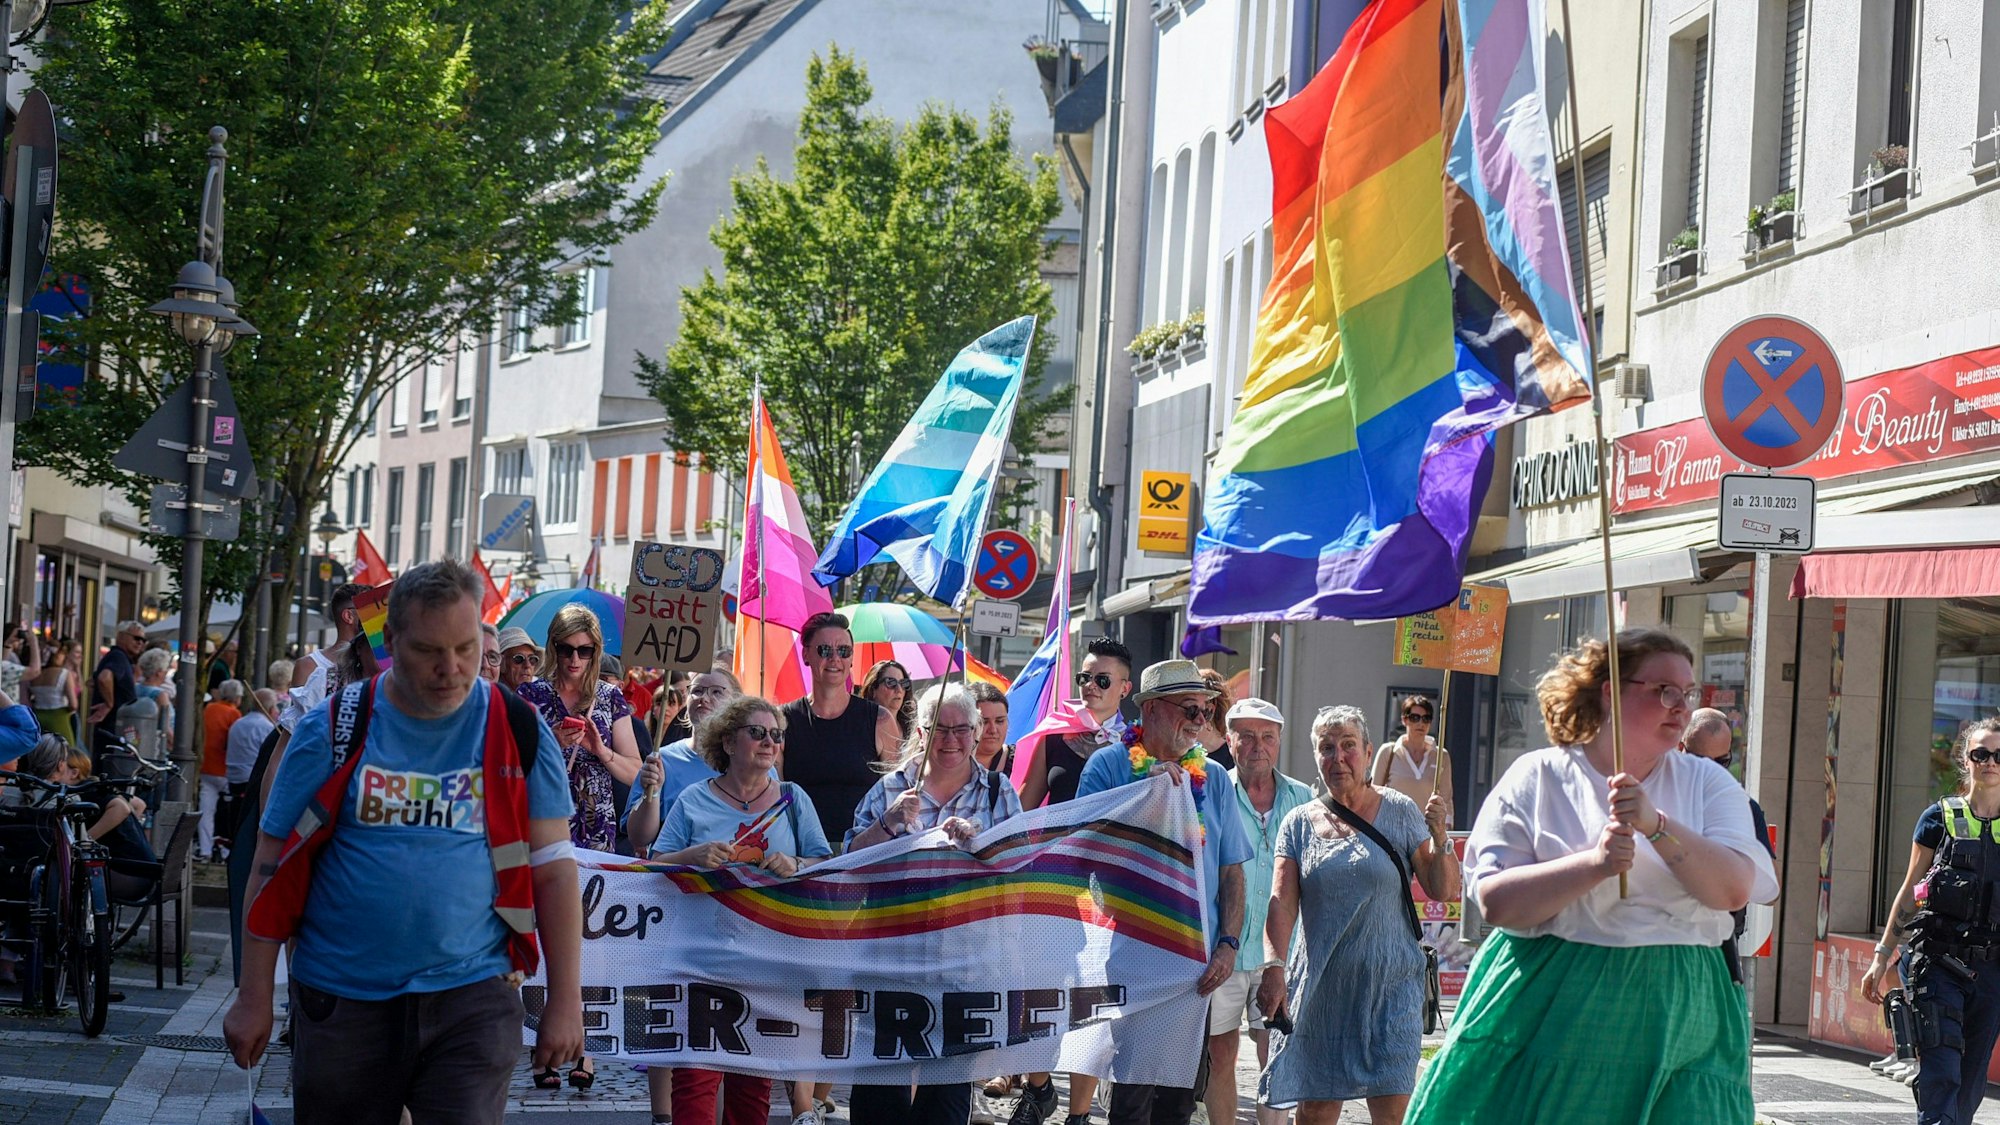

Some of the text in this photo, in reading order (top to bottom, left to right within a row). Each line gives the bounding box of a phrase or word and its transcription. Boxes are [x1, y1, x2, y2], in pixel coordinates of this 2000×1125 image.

[1654, 436, 1722, 499] Hanna
[1852, 387, 1949, 454] Beauty
[1512, 453, 1548, 508] OPTIK
[1732, 495, 1797, 509] ab 23.10.2023
[1146, 530, 1180, 540] DHL
[635, 543, 724, 592] CSD
[631, 590, 708, 625] statt
[633, 622, 701, 664] AfD
